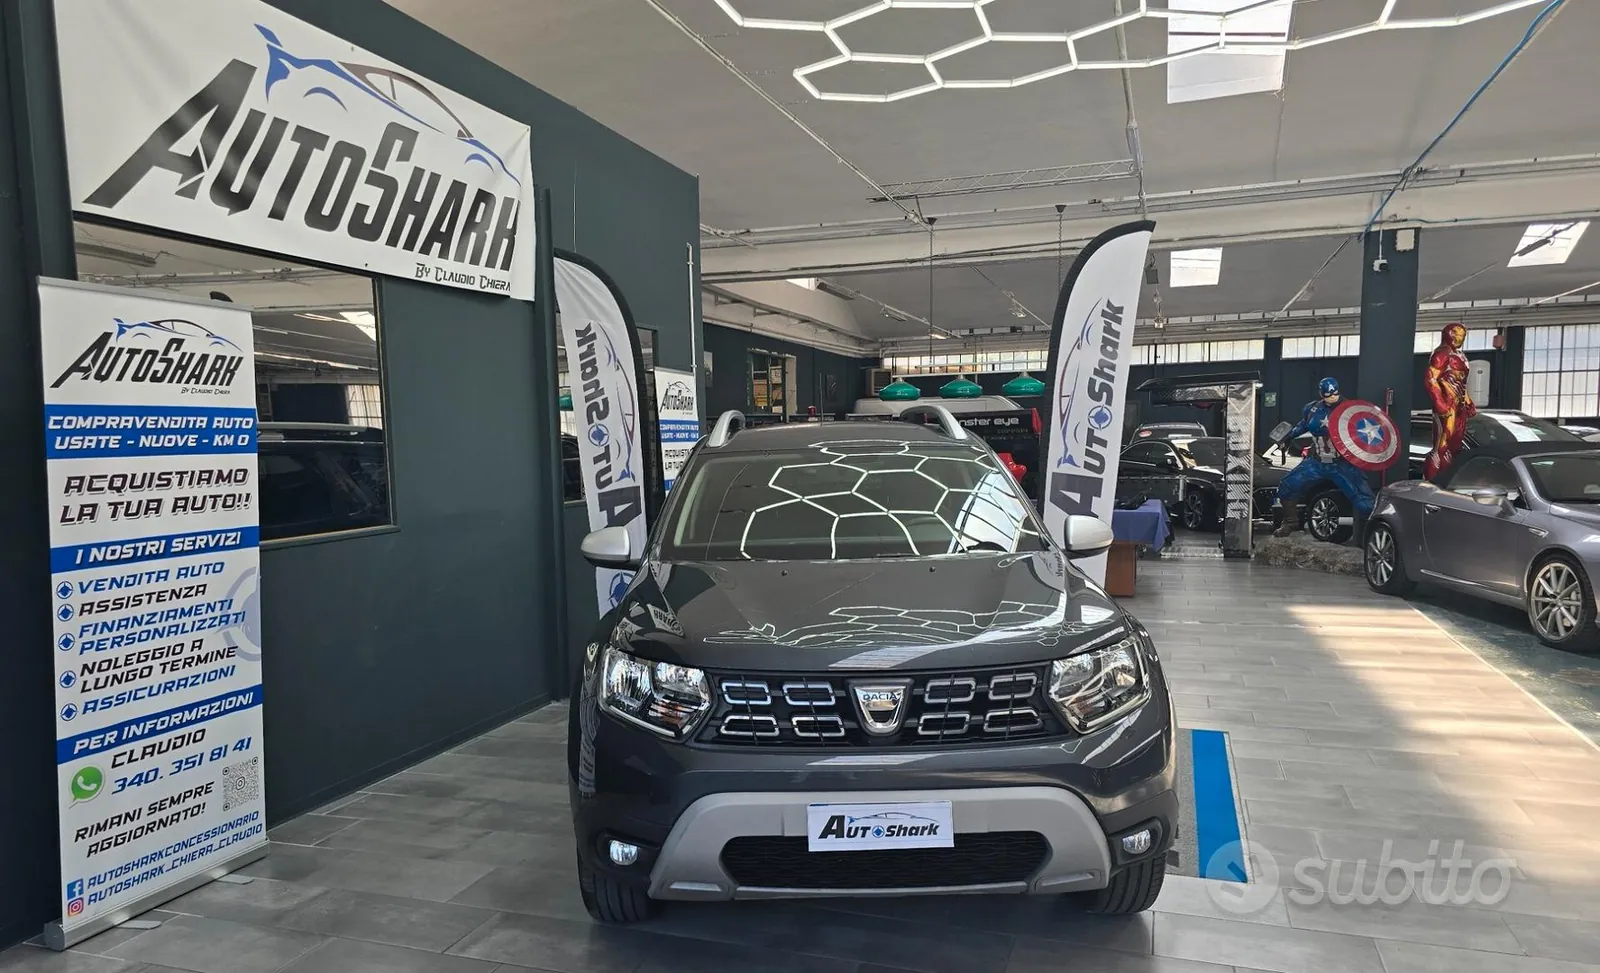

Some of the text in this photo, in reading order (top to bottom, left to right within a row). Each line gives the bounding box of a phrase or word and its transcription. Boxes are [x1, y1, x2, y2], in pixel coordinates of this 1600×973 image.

[415, 262, 511, 291] BY CLAUDIO CHIERA
[50, 331, 244, 388] AUTOSHARK
[48, 415, 254, 430] COMPRAVENDITA AUTO
[54, 435, 122, 450] USATE
[138, 434, 199, 448] NUOVE
[212, 434, 234, 447] KM
[957, 417, 1019, 427] nster eye
[63, 468, 249, 496] ACQUISTIAMO
[59, 493, 252, 525] LA TUA AUTO!!
[75, 531, 242, 564] I NOSTRI SERVIZI
[78, 561, 225, 594] VENDITA AUTO
[78, 583, 208, 617] ASSISTENZA
[78, 598, 234, 639] FINANZIAMENTI
[79, 610, 247, 656] PERSONALIZZATI
[79, 638, 205, 678] NOLEGGIO A
[80, 645, 239, 694] LUNGO TERMINE
[81, 664, 237, 715] ASSICURAZIONI
[862, 692, 898, 701] DACIA
[73, 691, 254, 755] PER INFORMAZIONI
[110, 728, 207, 769] CLAUDIO
[111, 736, 252, 795] 340. 351 81 41
[74, 781, 216, 843] RIMANI SEMPRE
[86, 802, 207, 858] AGGIORNATO!
[86, 810, 260, 890] AUTOSHARKCONCESSIONARIO
[87, 823, 263, 906] AUTOSHARK_CHIERA_CLAUDIO
